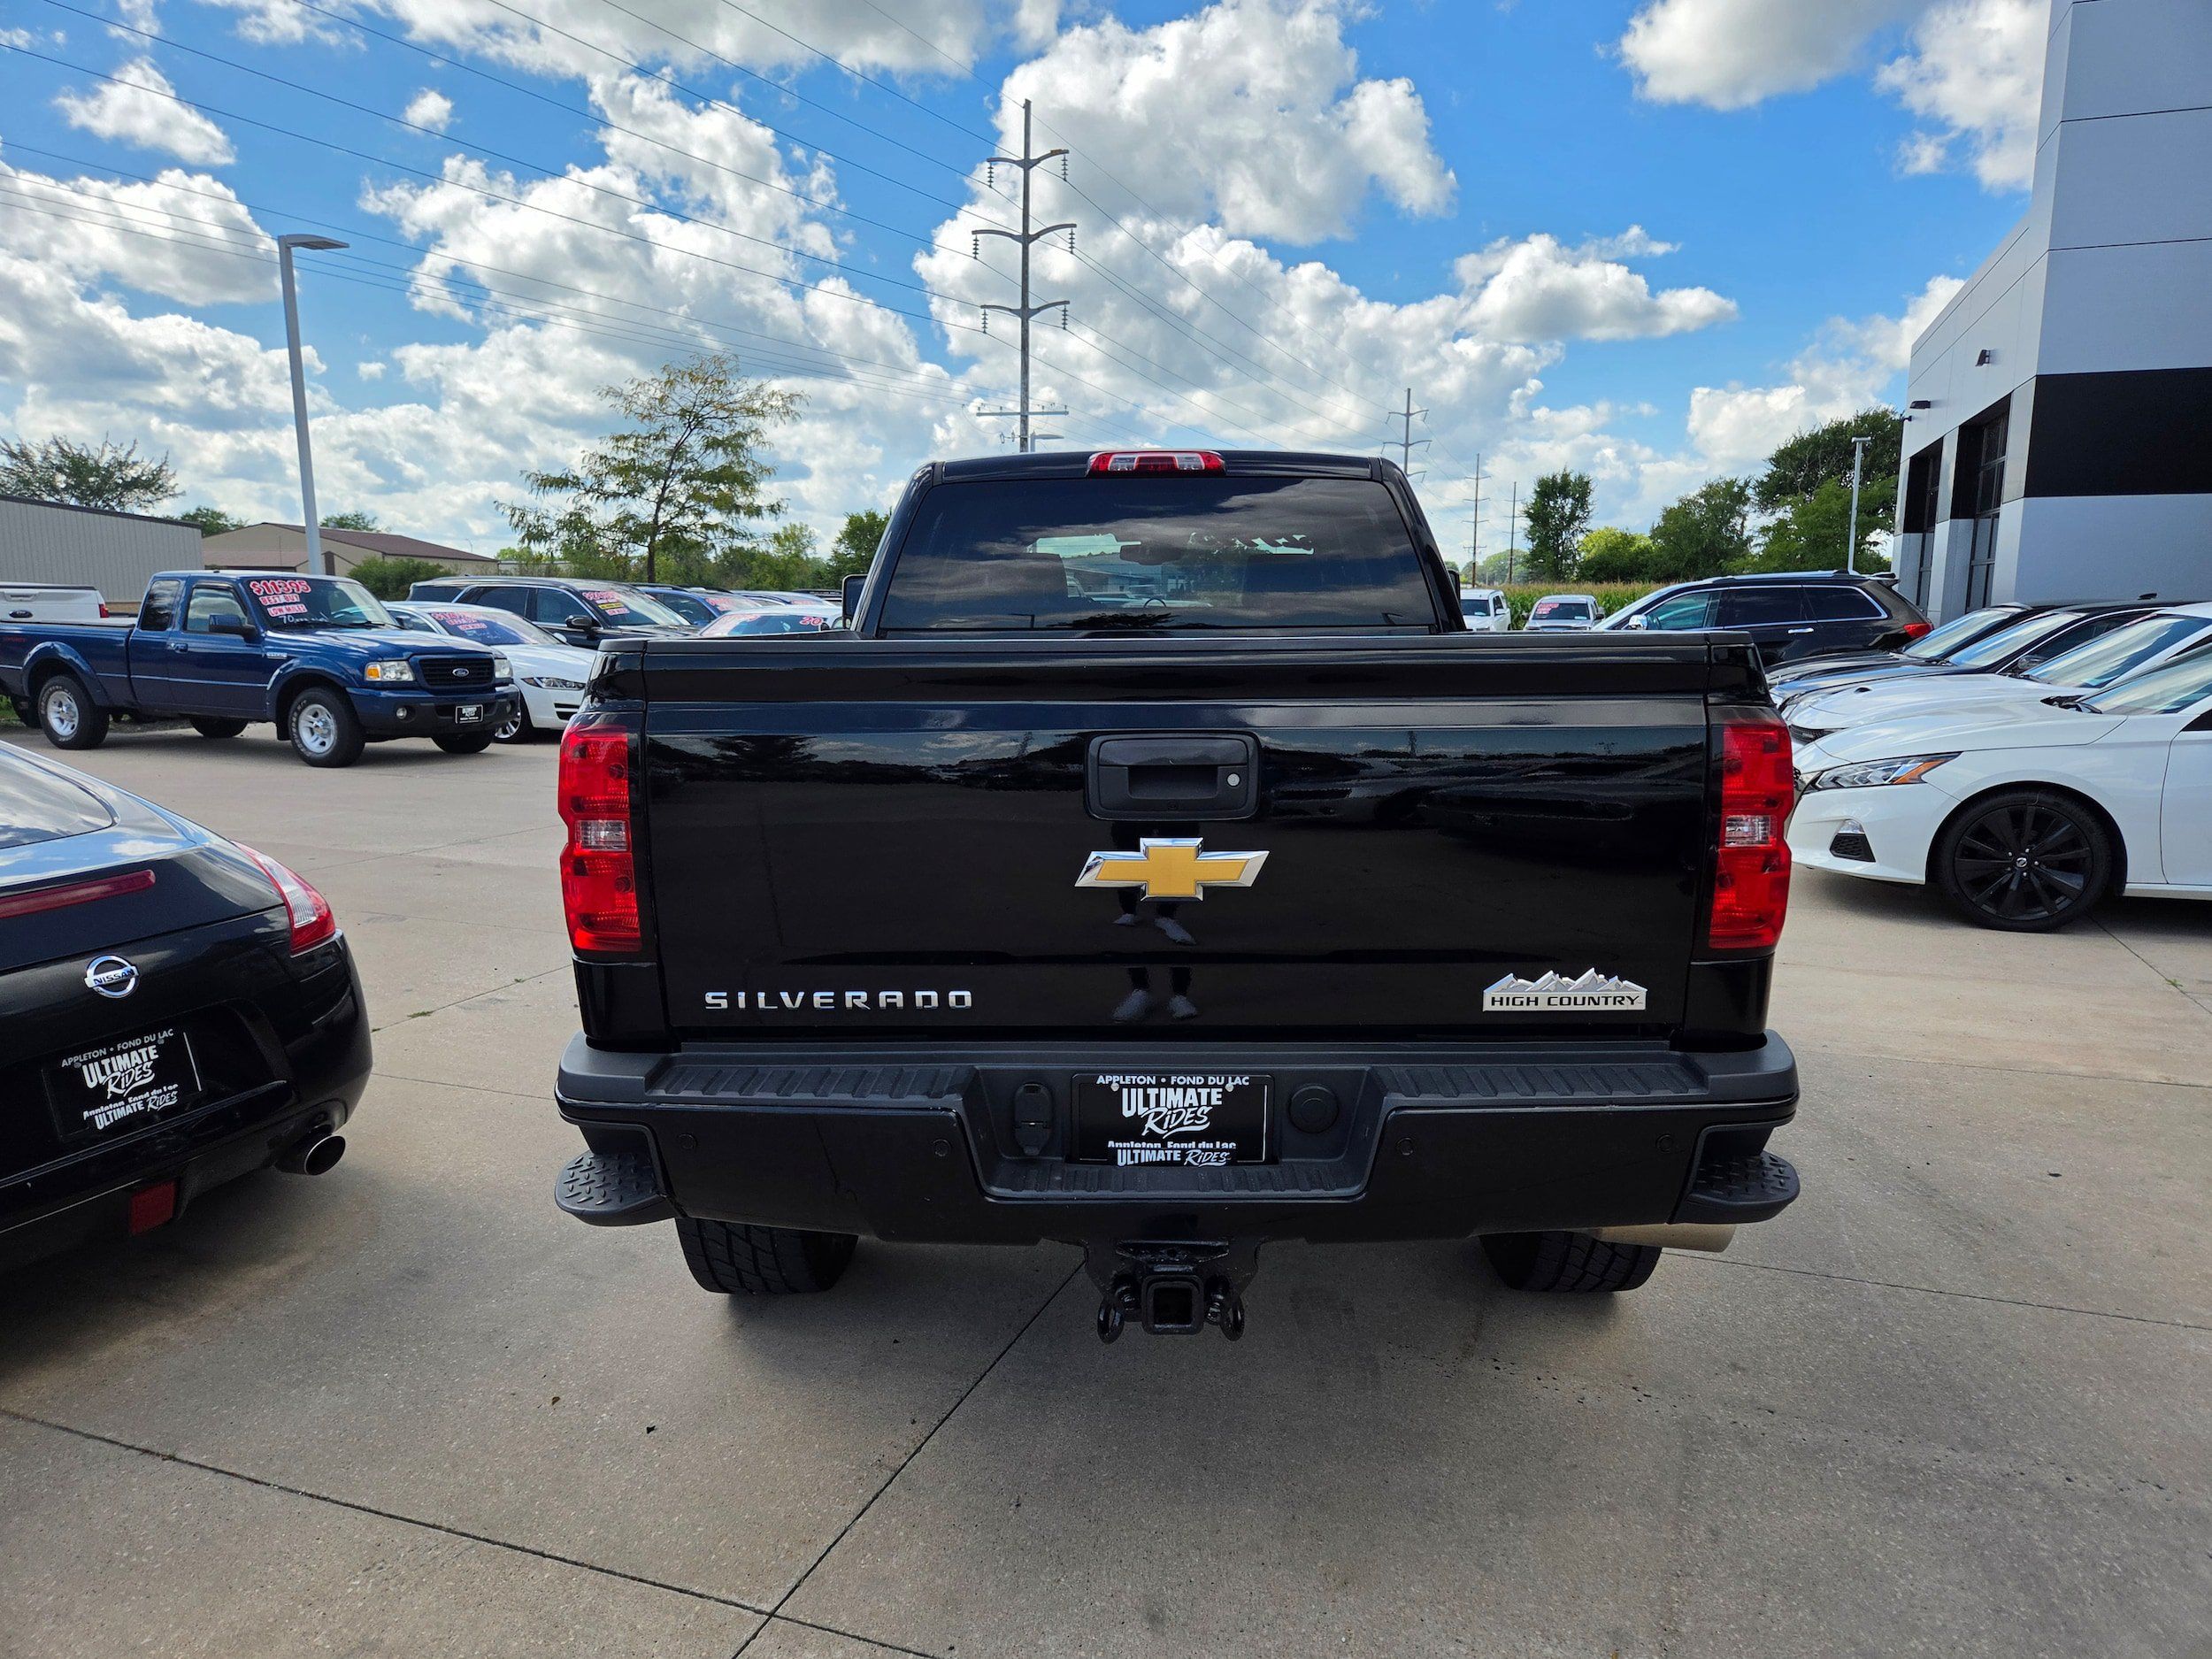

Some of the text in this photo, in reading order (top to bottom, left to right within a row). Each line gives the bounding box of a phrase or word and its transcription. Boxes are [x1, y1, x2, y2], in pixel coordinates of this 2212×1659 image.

[250, 580, 311, 595] $11395
[93, 969, 135, 985] NISSAN
[704, 990, 972, 1010] SILVERADO
[1491, 995, 1640, 1007] HIGH COUNTRY
[61, 1028, 175, 1067] APPLETON FOND DU LAC
[81, 1045, 159, 1088] ULTIMATE
[1095, 1075, 1250, 1086] APPLETON FOND DU LAC
[1121, 1087, 1224, 1118] ULTIMATE
[94, 1101, 146, 1130] ULTIMATE
[1117, 1148, 1182, 1167] ULTIMATE
